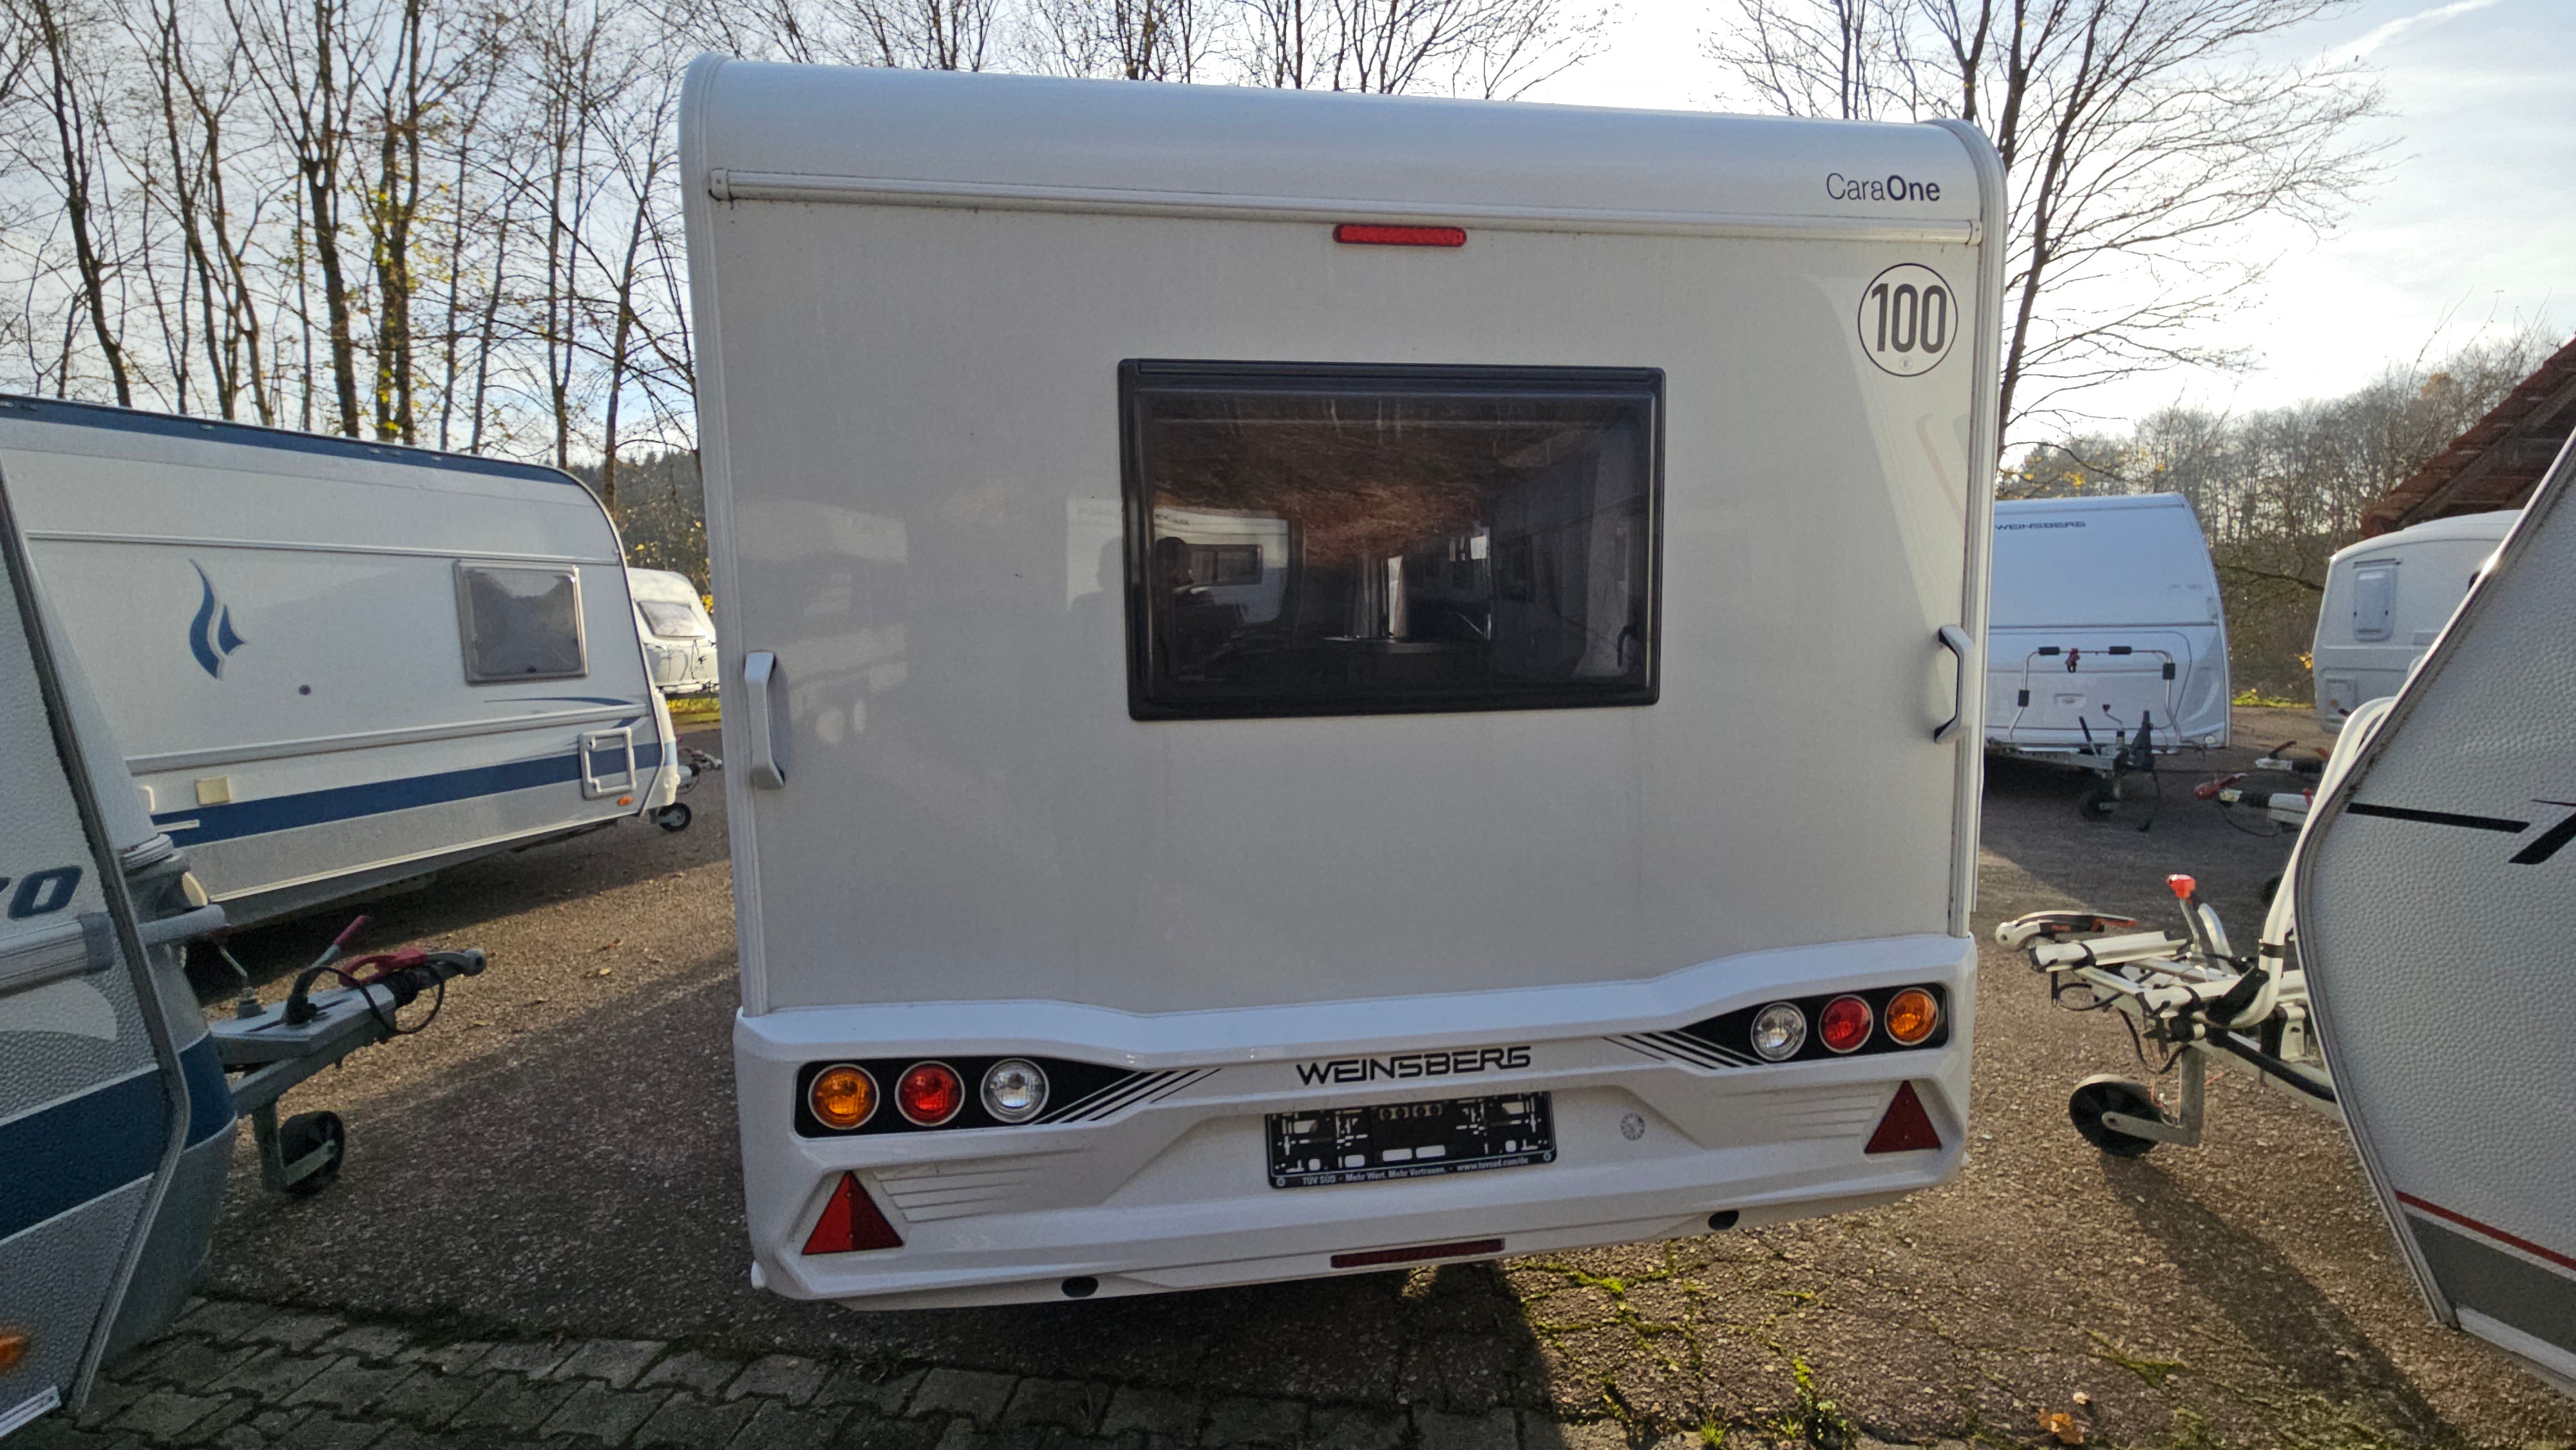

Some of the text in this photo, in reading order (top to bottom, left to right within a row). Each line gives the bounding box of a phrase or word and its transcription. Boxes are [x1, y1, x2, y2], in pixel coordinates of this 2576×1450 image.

[1826, 173, 1940, 202] CaraOne
[1871, 283, 1947, 353] 100
[1995, 520, 2086, 531] WEINSBERG
[1296, 1046, 1531, 1086] WEINSBERG
[1345, 1173, 1366, 1182] Mehr
[1388, 1169, 1408, 1178] Mehr
